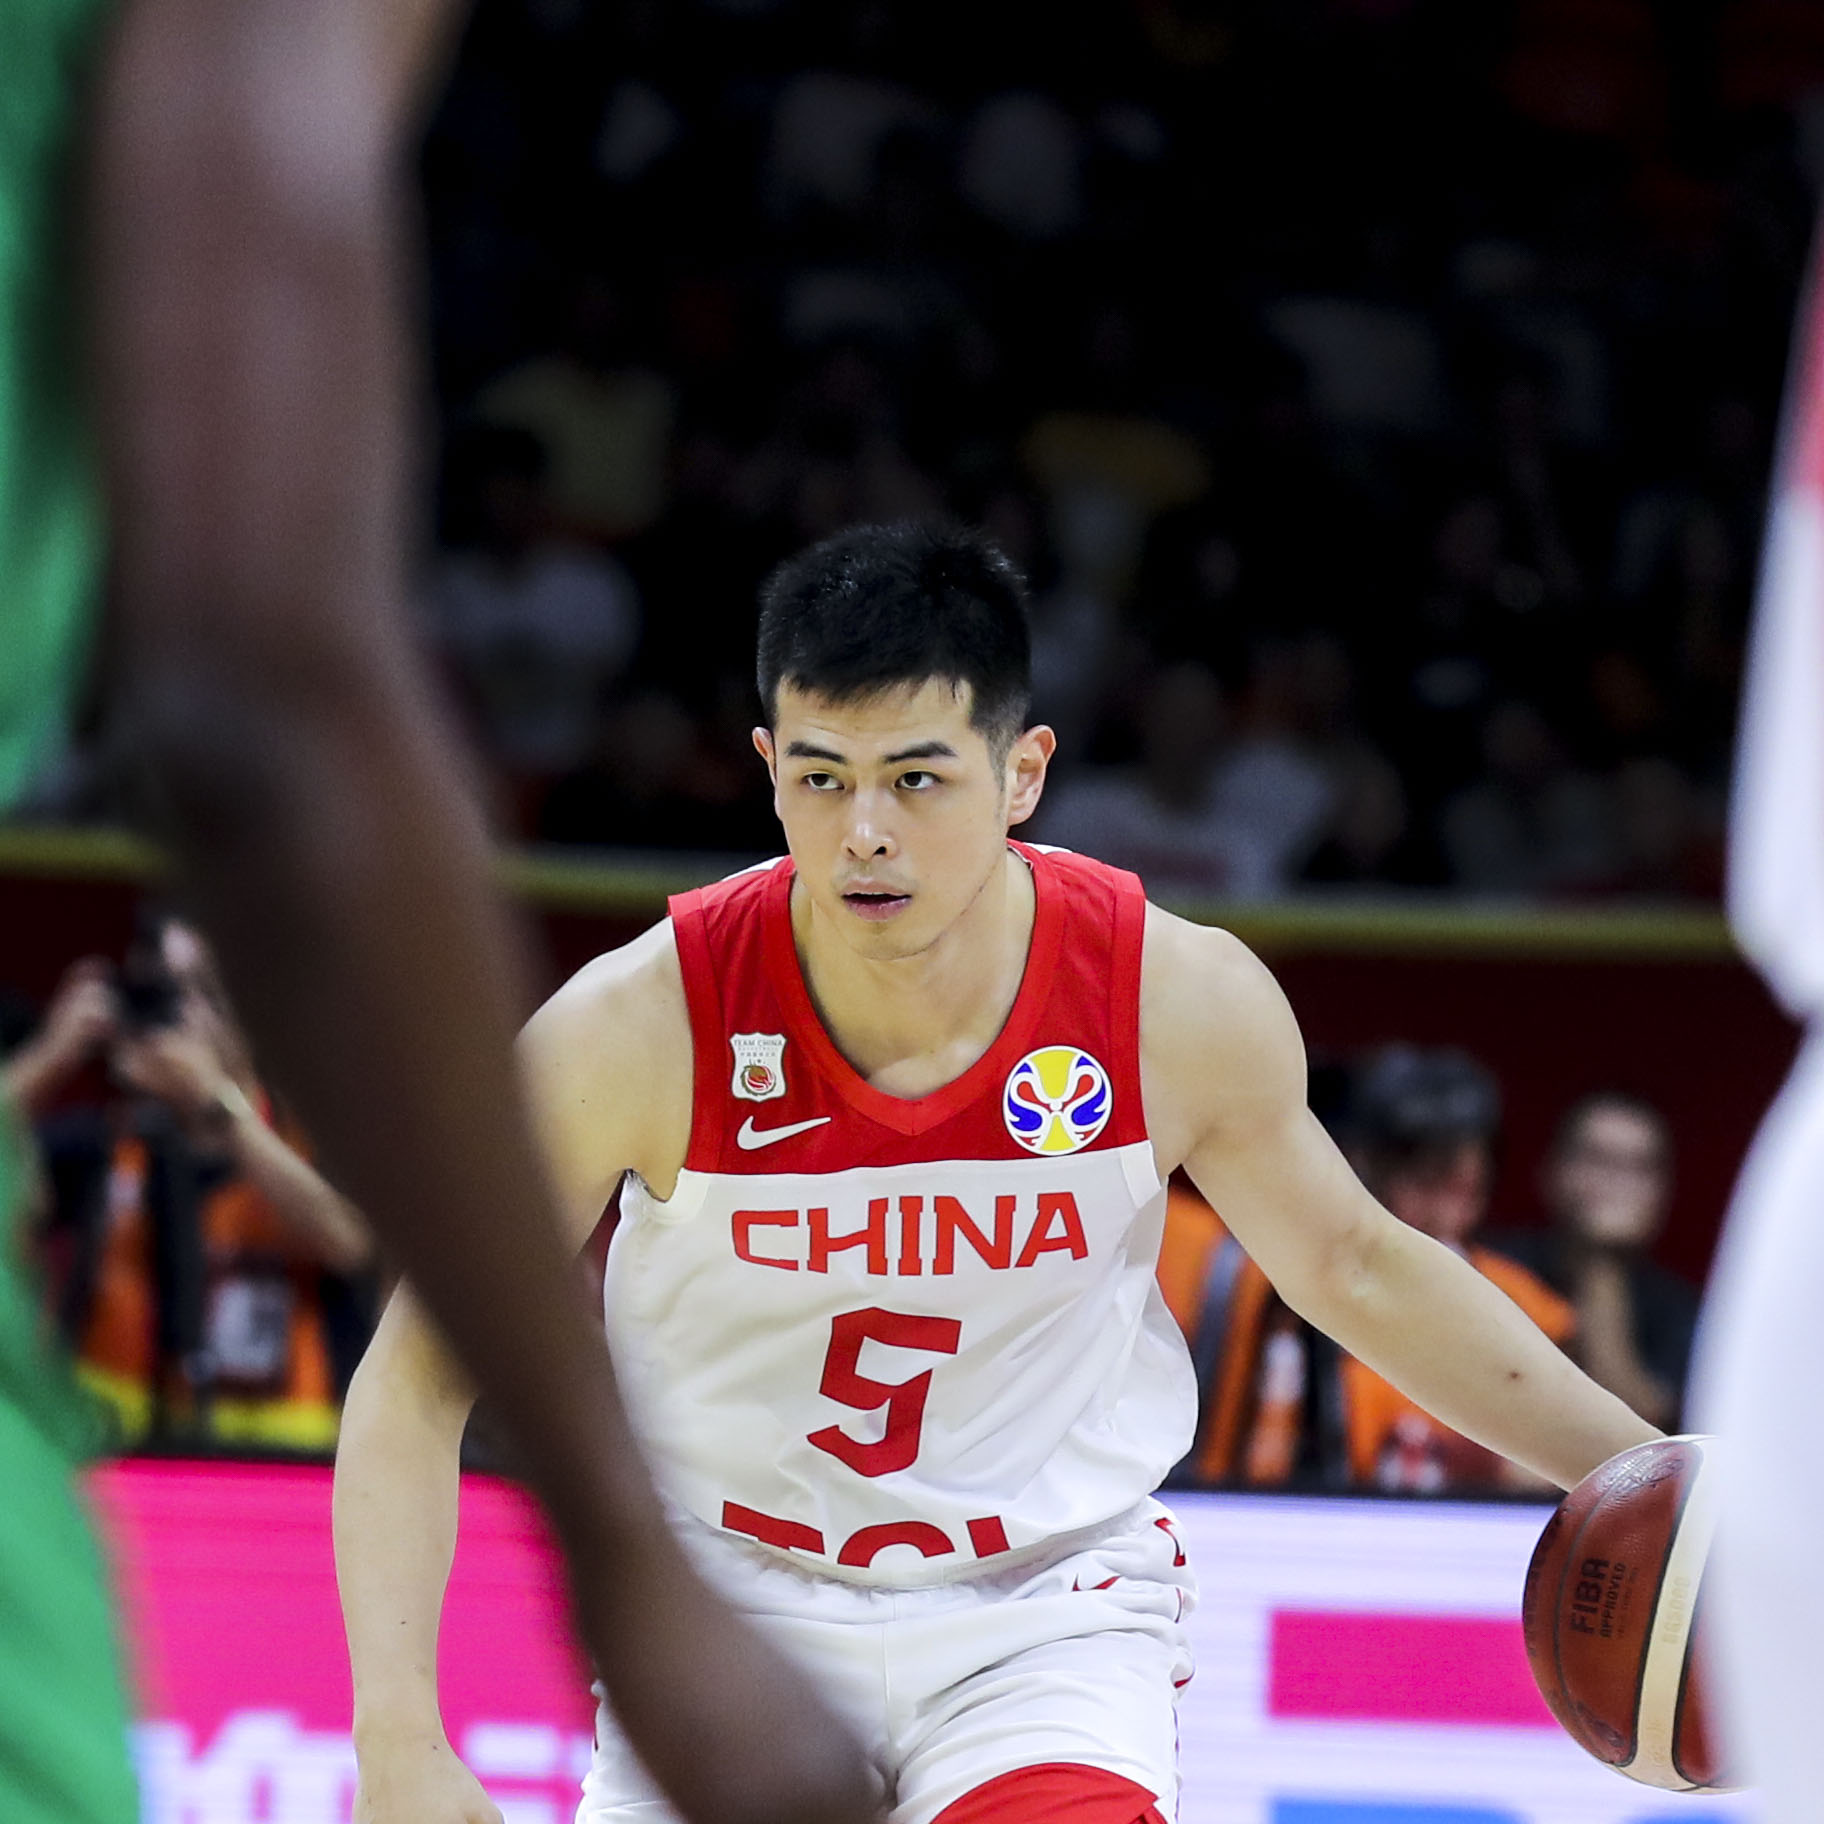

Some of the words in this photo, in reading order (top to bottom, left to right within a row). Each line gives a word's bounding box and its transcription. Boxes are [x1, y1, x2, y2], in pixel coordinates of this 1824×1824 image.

[731, 1191, 1089, 1276] CHINA
[806, 1306, 962, 1478] 5
[1569, 1558, 1610, 1635] FIBA
[1600, 1562, 1626, 1638] APPROVED
